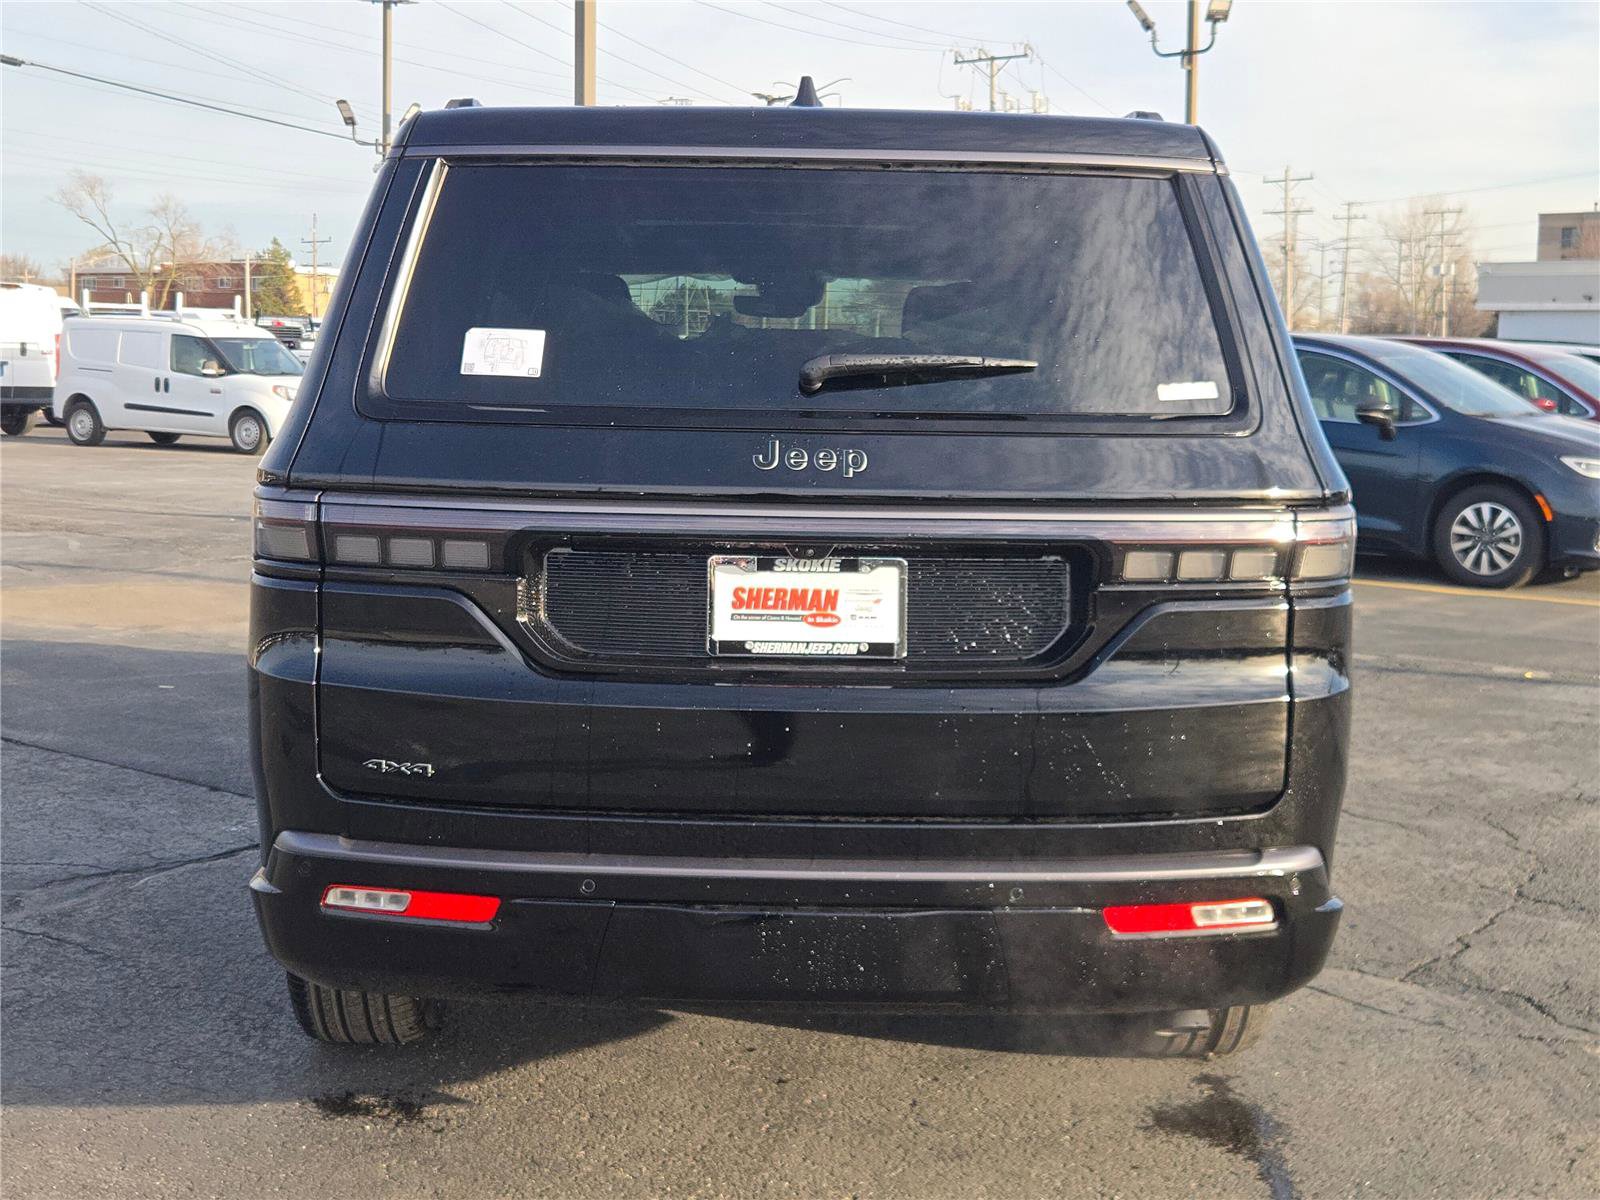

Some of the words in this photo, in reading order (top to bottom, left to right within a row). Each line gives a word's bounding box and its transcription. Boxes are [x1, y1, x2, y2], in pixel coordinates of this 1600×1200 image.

[753, 440, 867, 477] Jeep
[773, 559, 841, 572] SKOKIE
[731, 586, 839, 612] SHERMAN
[751, 641, 858, 655] SHERMANJEEP.COM
